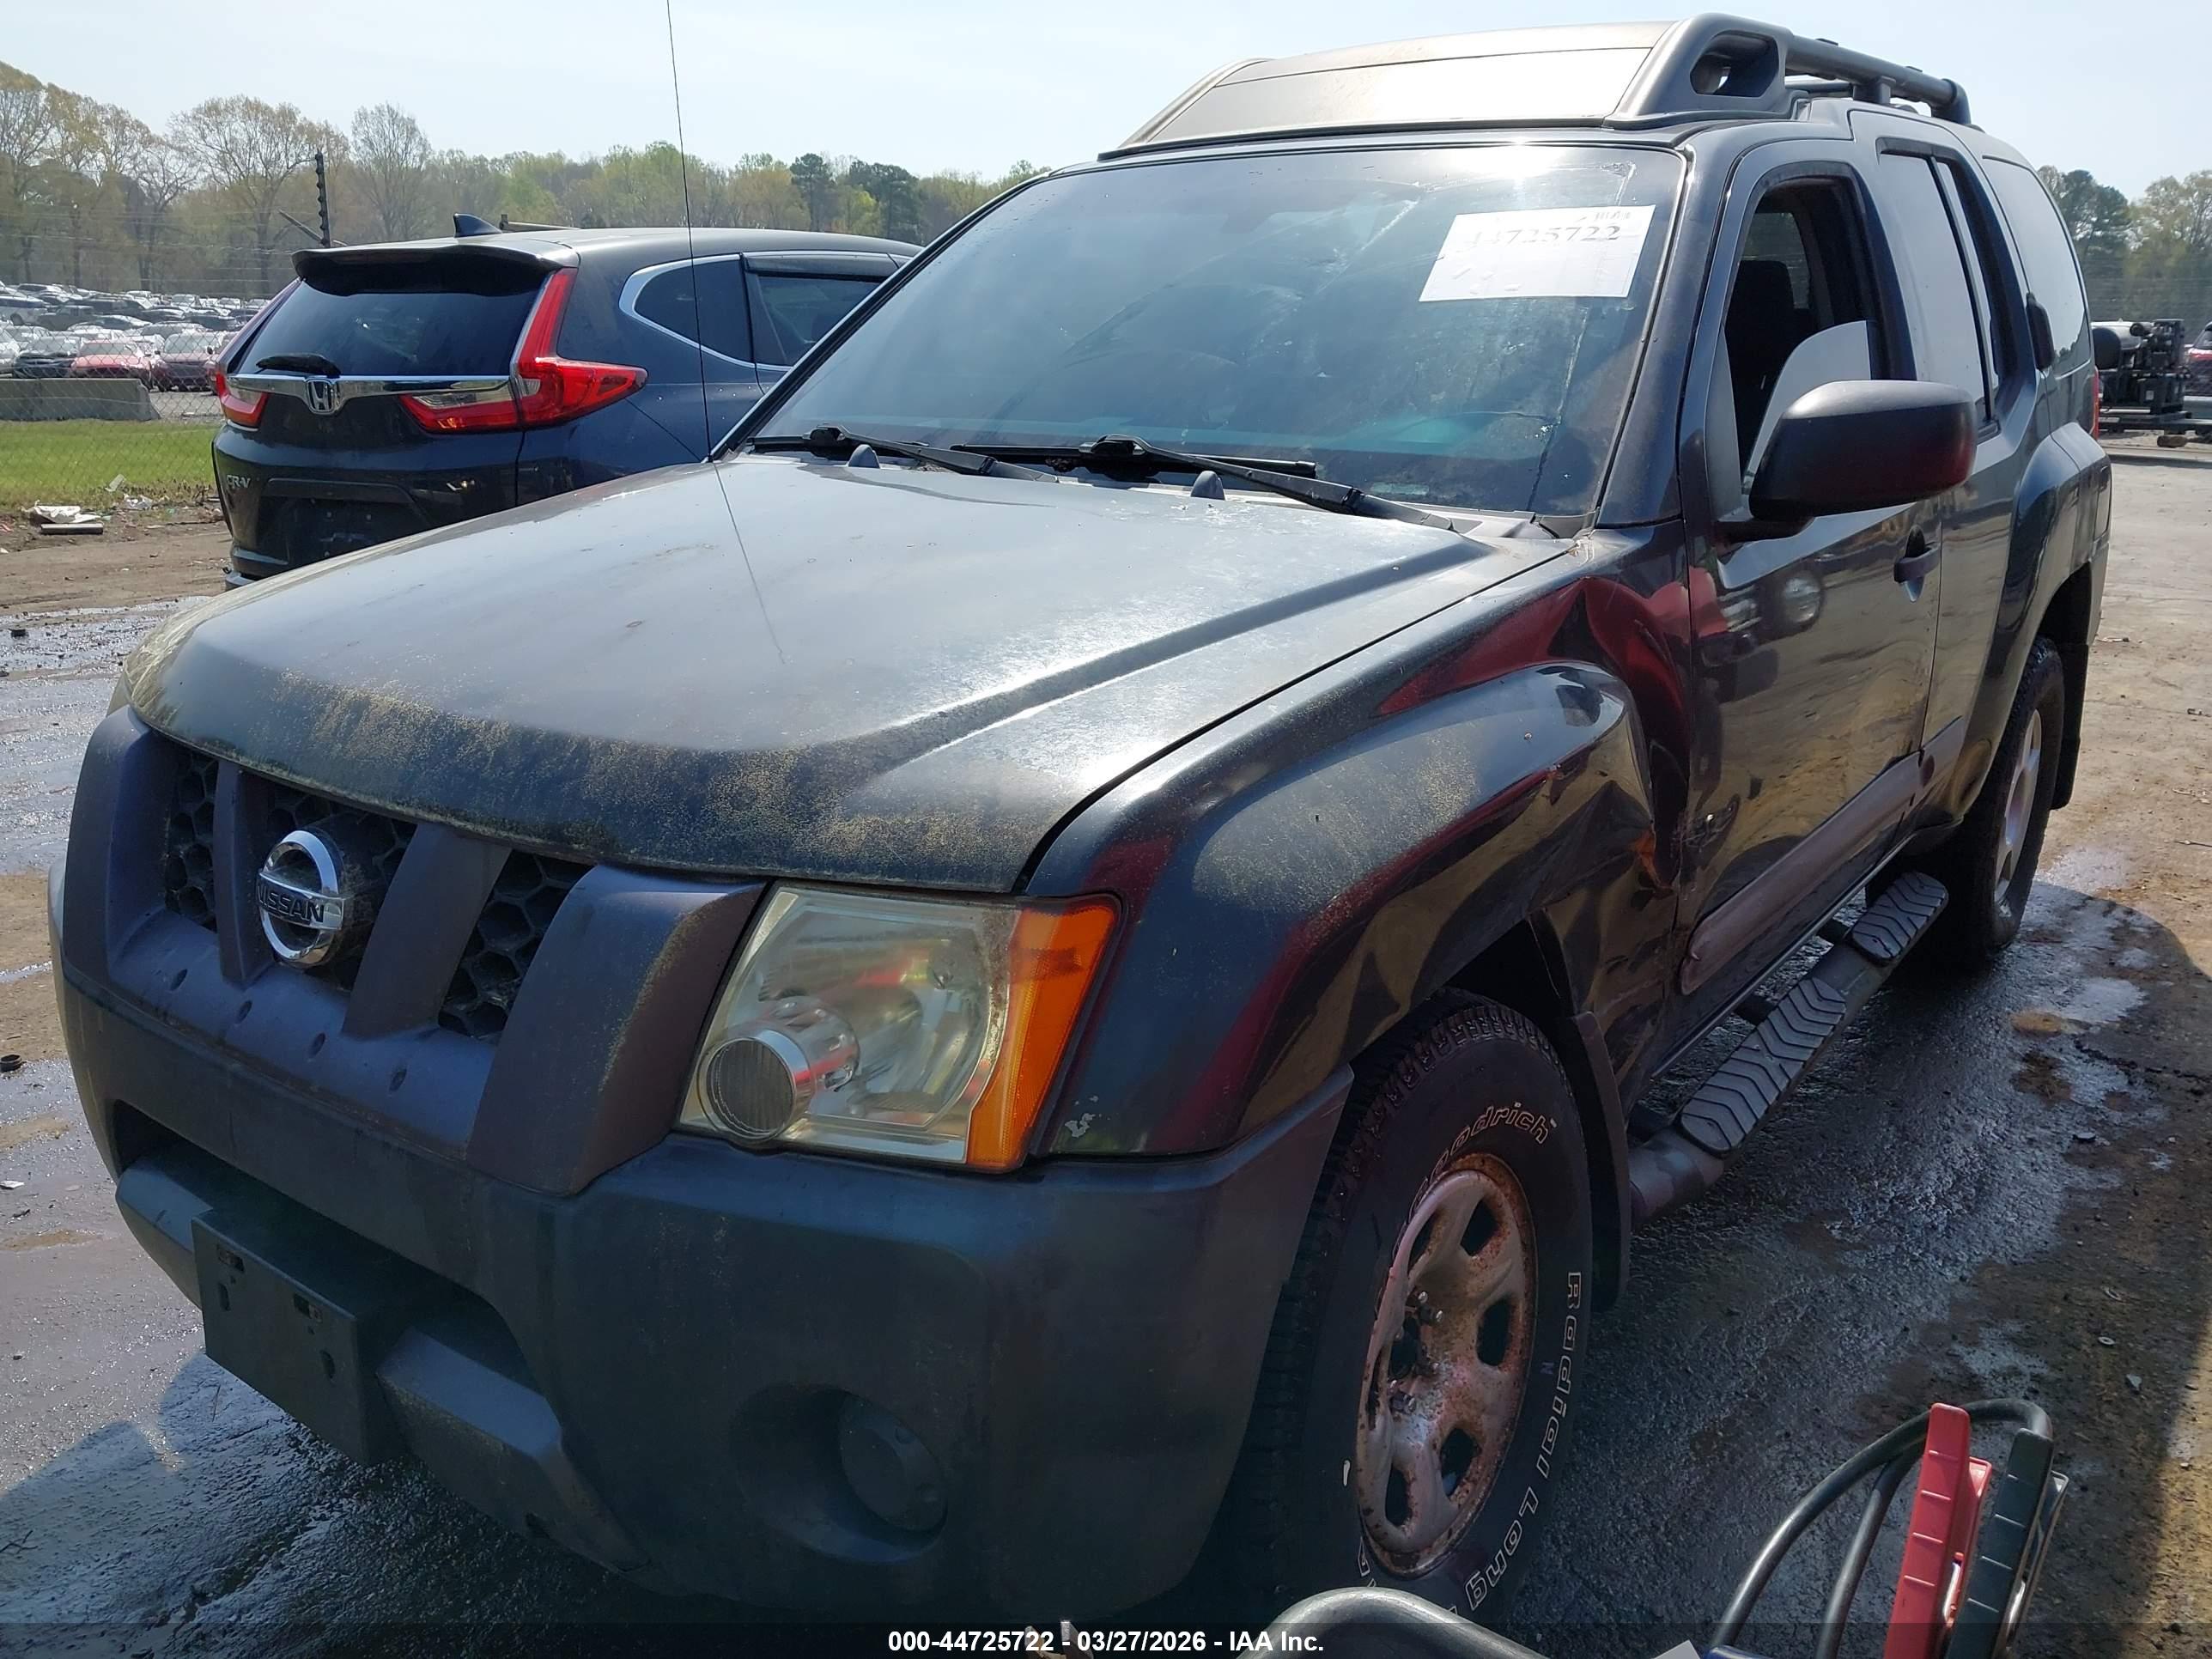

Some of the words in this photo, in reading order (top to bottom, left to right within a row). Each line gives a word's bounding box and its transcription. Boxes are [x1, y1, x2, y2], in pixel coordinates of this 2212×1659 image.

[1464, 225, 1621, 246] 725722
[226, 474, 251, 489] CR-V
[256, 885, 325, 923] NISSAN
[1535, 1271, 1583, 1480] Radial
[1463, 1486, 1540, 1612] Long
